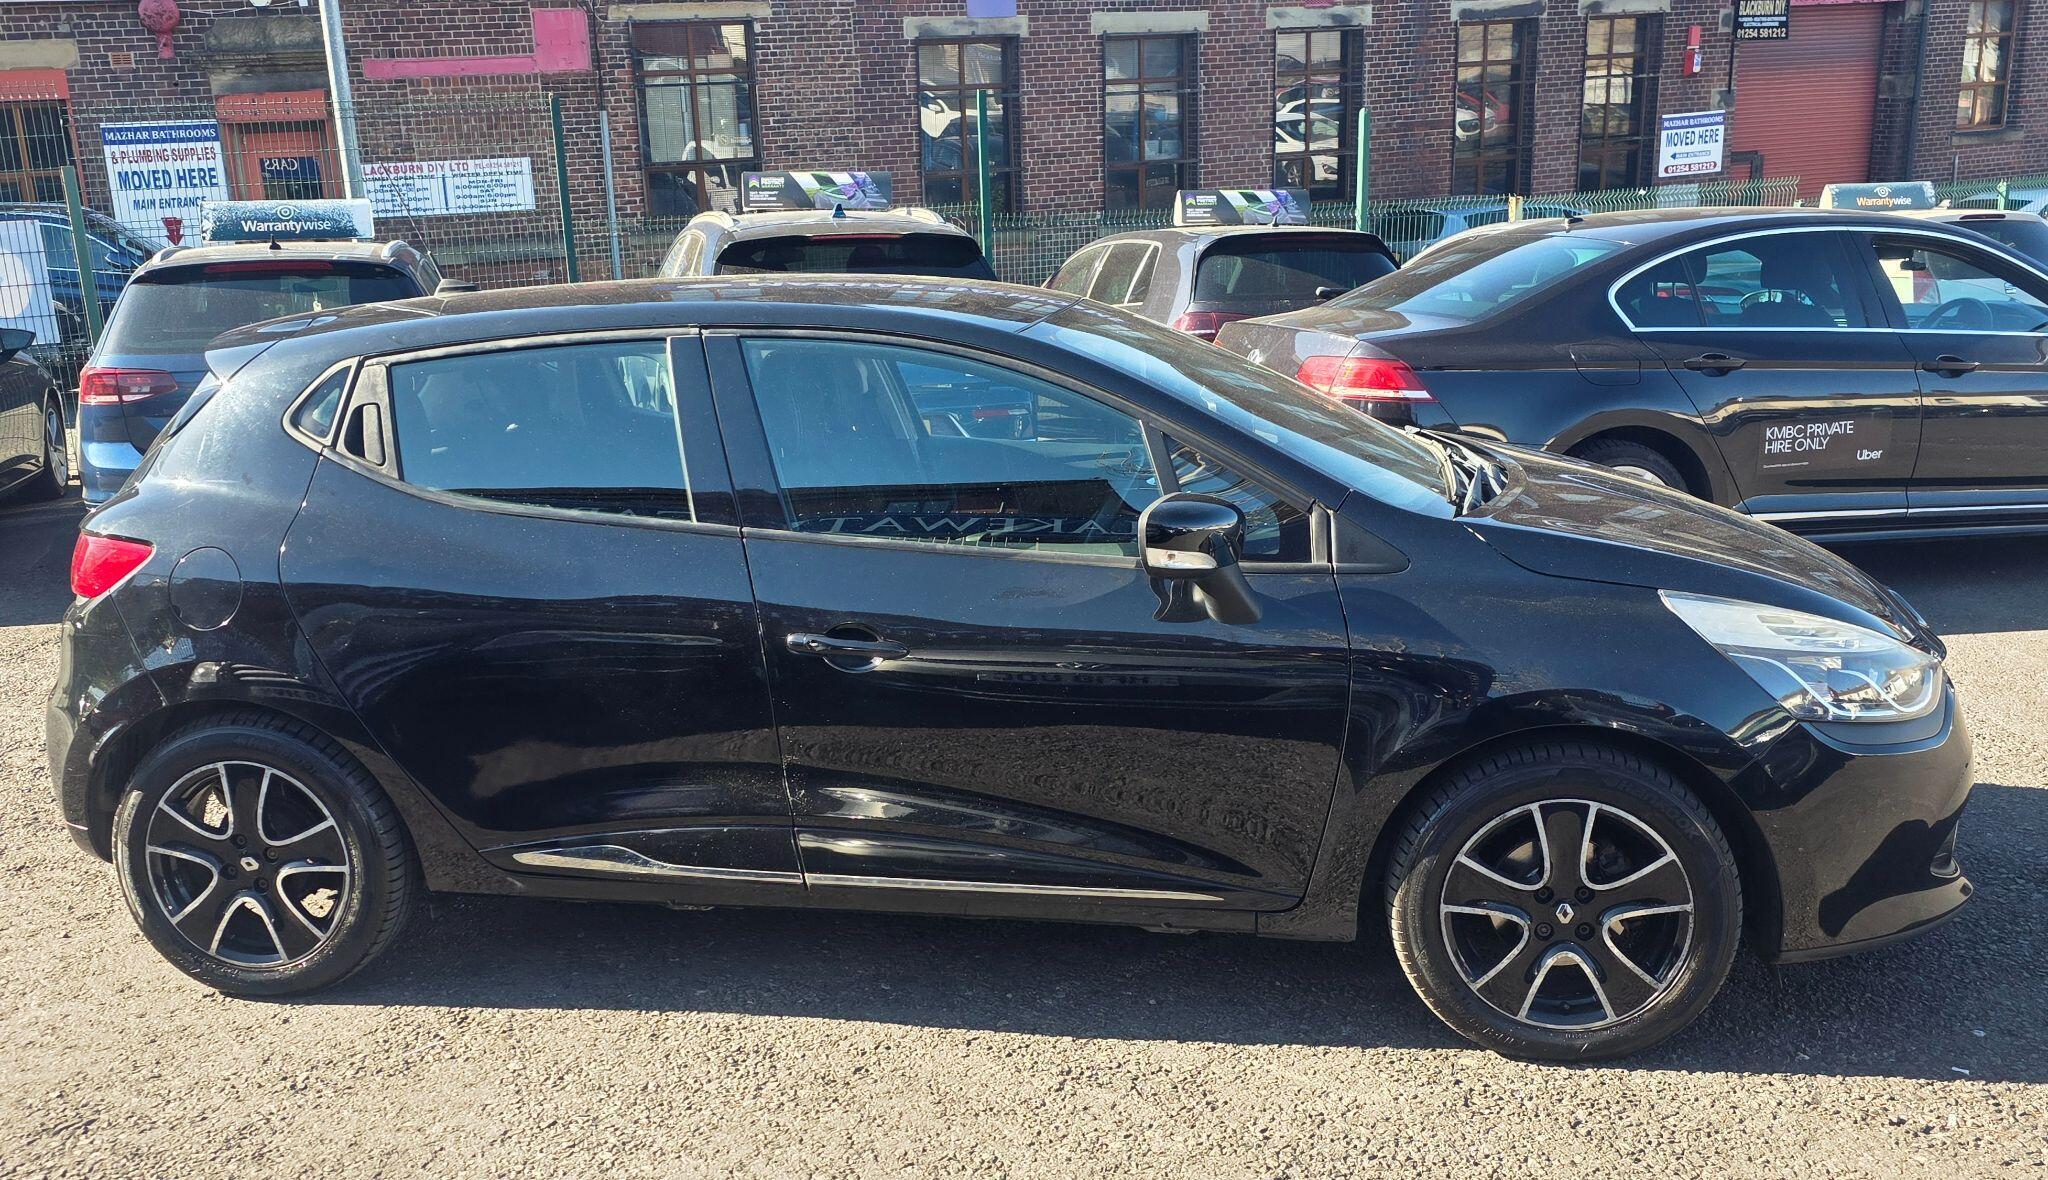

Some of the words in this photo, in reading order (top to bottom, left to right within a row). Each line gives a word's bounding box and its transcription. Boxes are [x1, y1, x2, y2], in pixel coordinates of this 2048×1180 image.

[1739, 0, 1774, 15] BLACKBURN
[1775, 0, 1786, 15] DIY
[1736, 29, 1758, 38] 01254
[1759, 28, 1786, 38] 581212
[1664, 119, 1689, 128] MAZHAR
[1689, 116, 1724, 125] BATHROOMS
[104, 131, 150, 141] MAZHAR
[151, 128, 216, 139] BATHROOMS
[1665, 130, 1696, 147] MOVED
[1697, 128, 1720, 145] HERE
[111, 150, 119, 164] &
[120, 148, 170, 164] PLUMBING
[171, 146, 217, 162] SUPPLIES
[363, 163, 424, 176] LACKBURN
[428, 163, 445, 173] DIY
[449, 162, 469, 171] LTD
[1667, 164, 1690, 173] 01254
[1690, 161, 1715, 172] 581212
[117, 169, 173, 191] MOVED
[175, 167, 219, 188] HERE
[133, 198, 156, 210] MAIN
[1856, 195, 1912, 208] Warrantywise
[241, 218, 332, 234] Warrantywise
[1765, 424, 1805, 440] KMBC
[1806, 420, 1855, 437] PRIVATE
[1764, 439, 1793, 454] HIRE
[1794, 436, 1830, 452] ONLY
[1856, 449, 1883, 461] Uber
